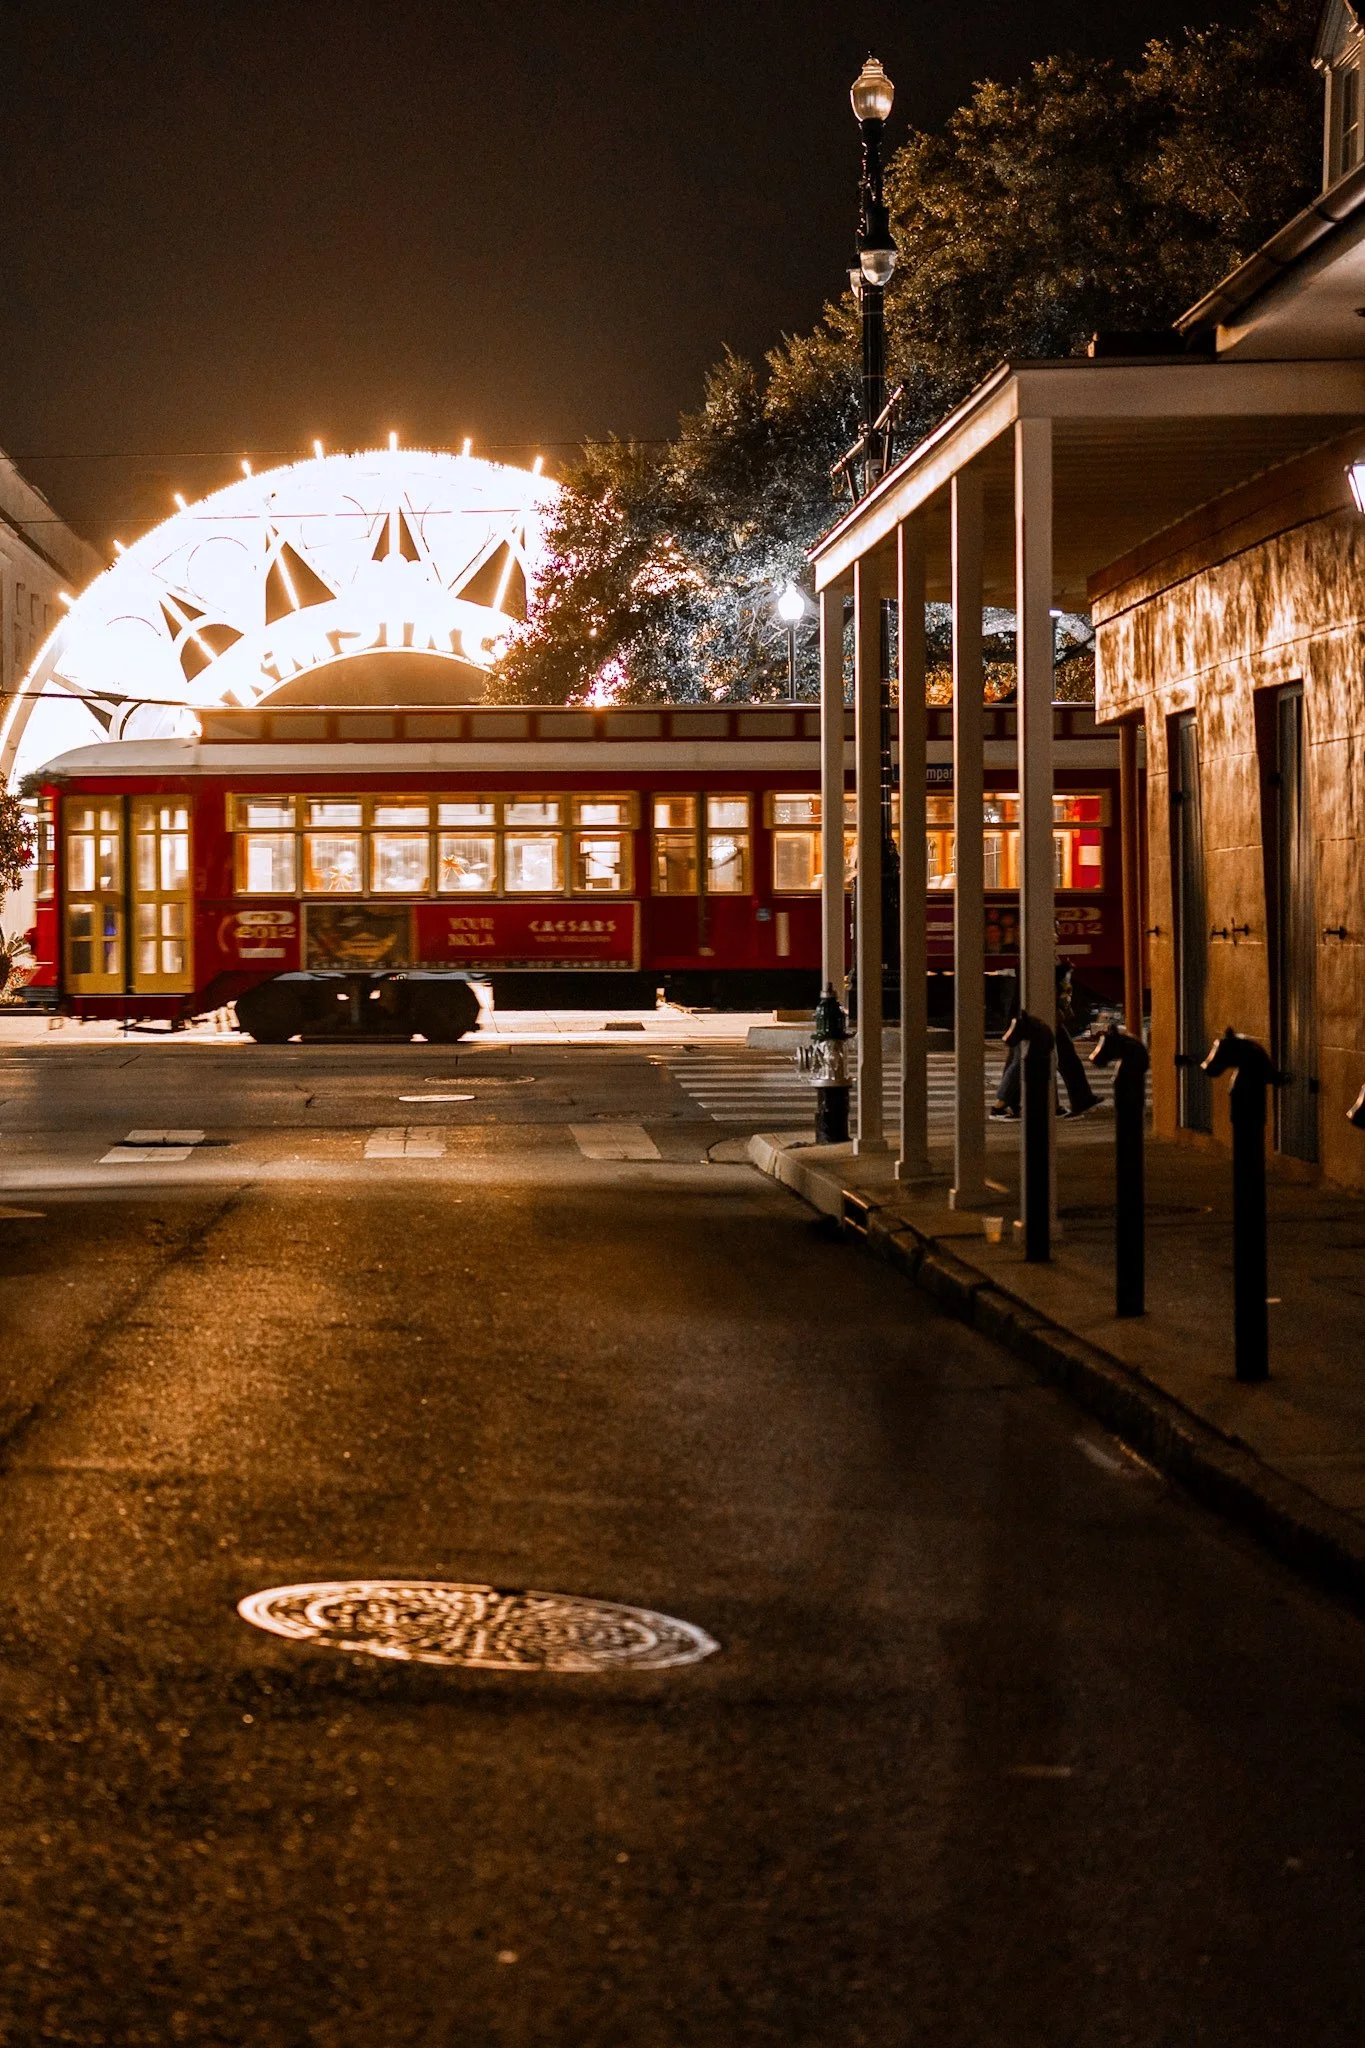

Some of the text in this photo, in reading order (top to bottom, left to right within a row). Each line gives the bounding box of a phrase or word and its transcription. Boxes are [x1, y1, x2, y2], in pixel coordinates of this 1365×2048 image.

[235, 926, 296, 939] 2012
[528, 920, 617, 932] CAESARS
[1057, 922, 1103, 935] 012
